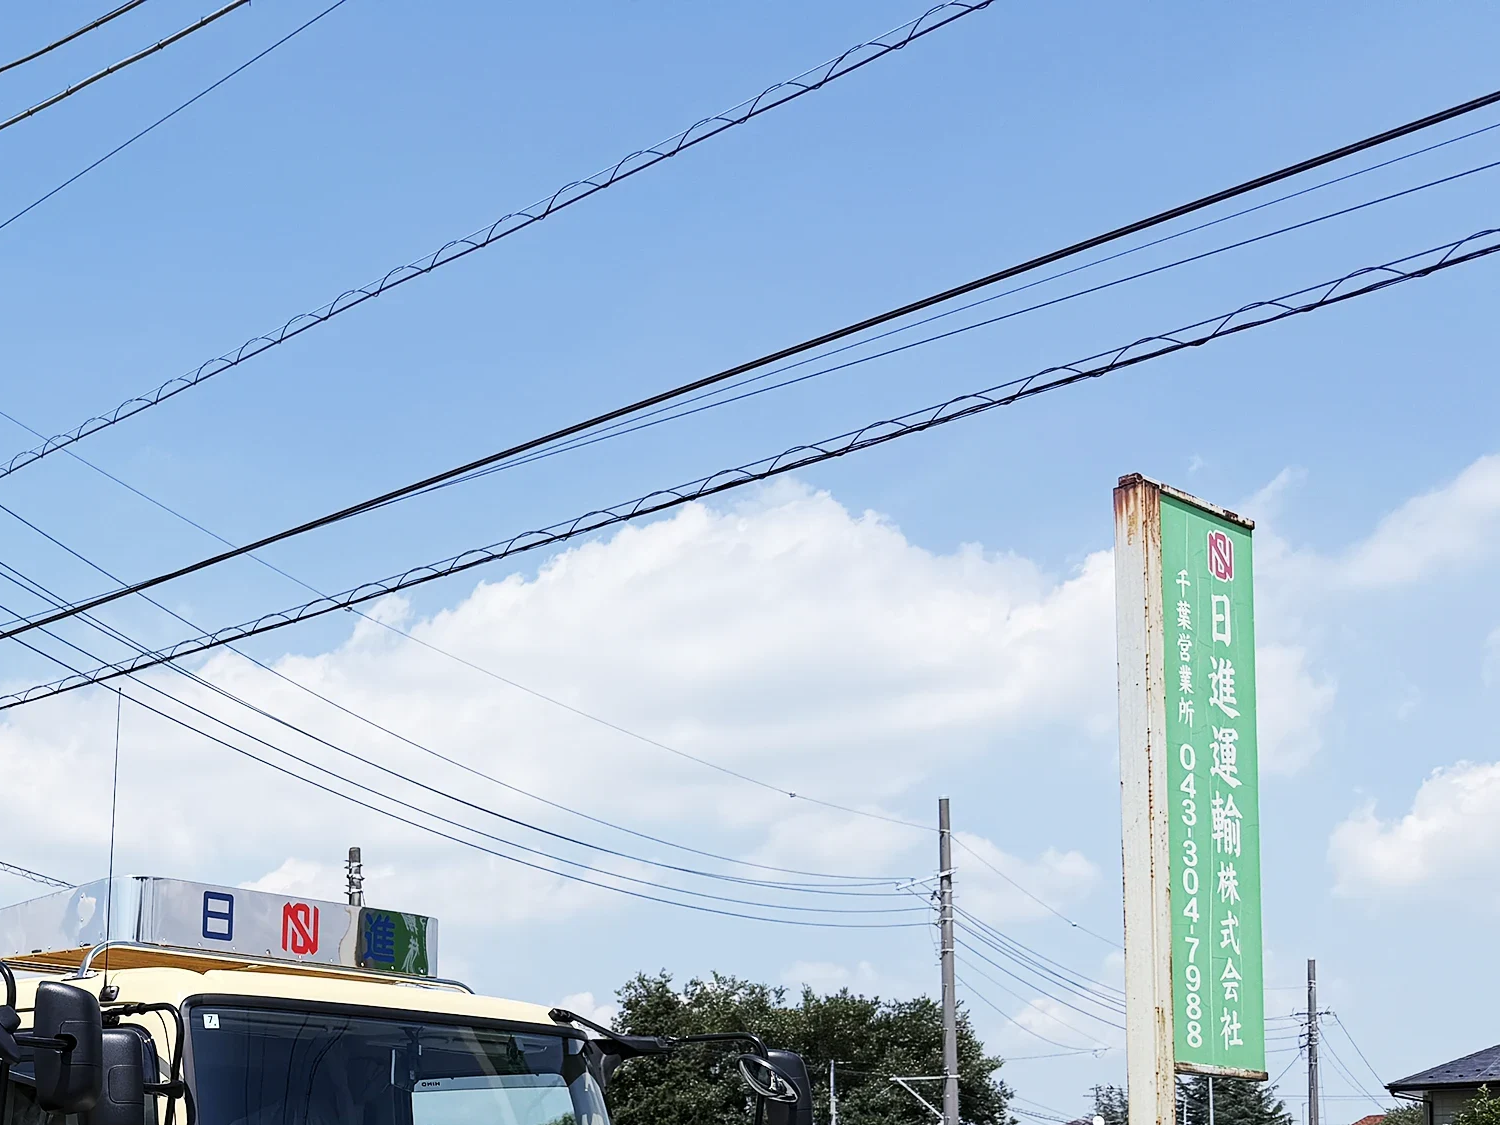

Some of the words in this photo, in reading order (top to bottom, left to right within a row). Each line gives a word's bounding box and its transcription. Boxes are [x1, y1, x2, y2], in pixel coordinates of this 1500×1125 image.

[1176, 569, 1195, 728] 千葉営業所
[202, 890, 234, 942] 日
[363, 912, 396, 963] 進
[1179, 743, 1203, 1048] 043-304-7988
[1208, 594, 1244, 1051] 日進運輸株式会社
